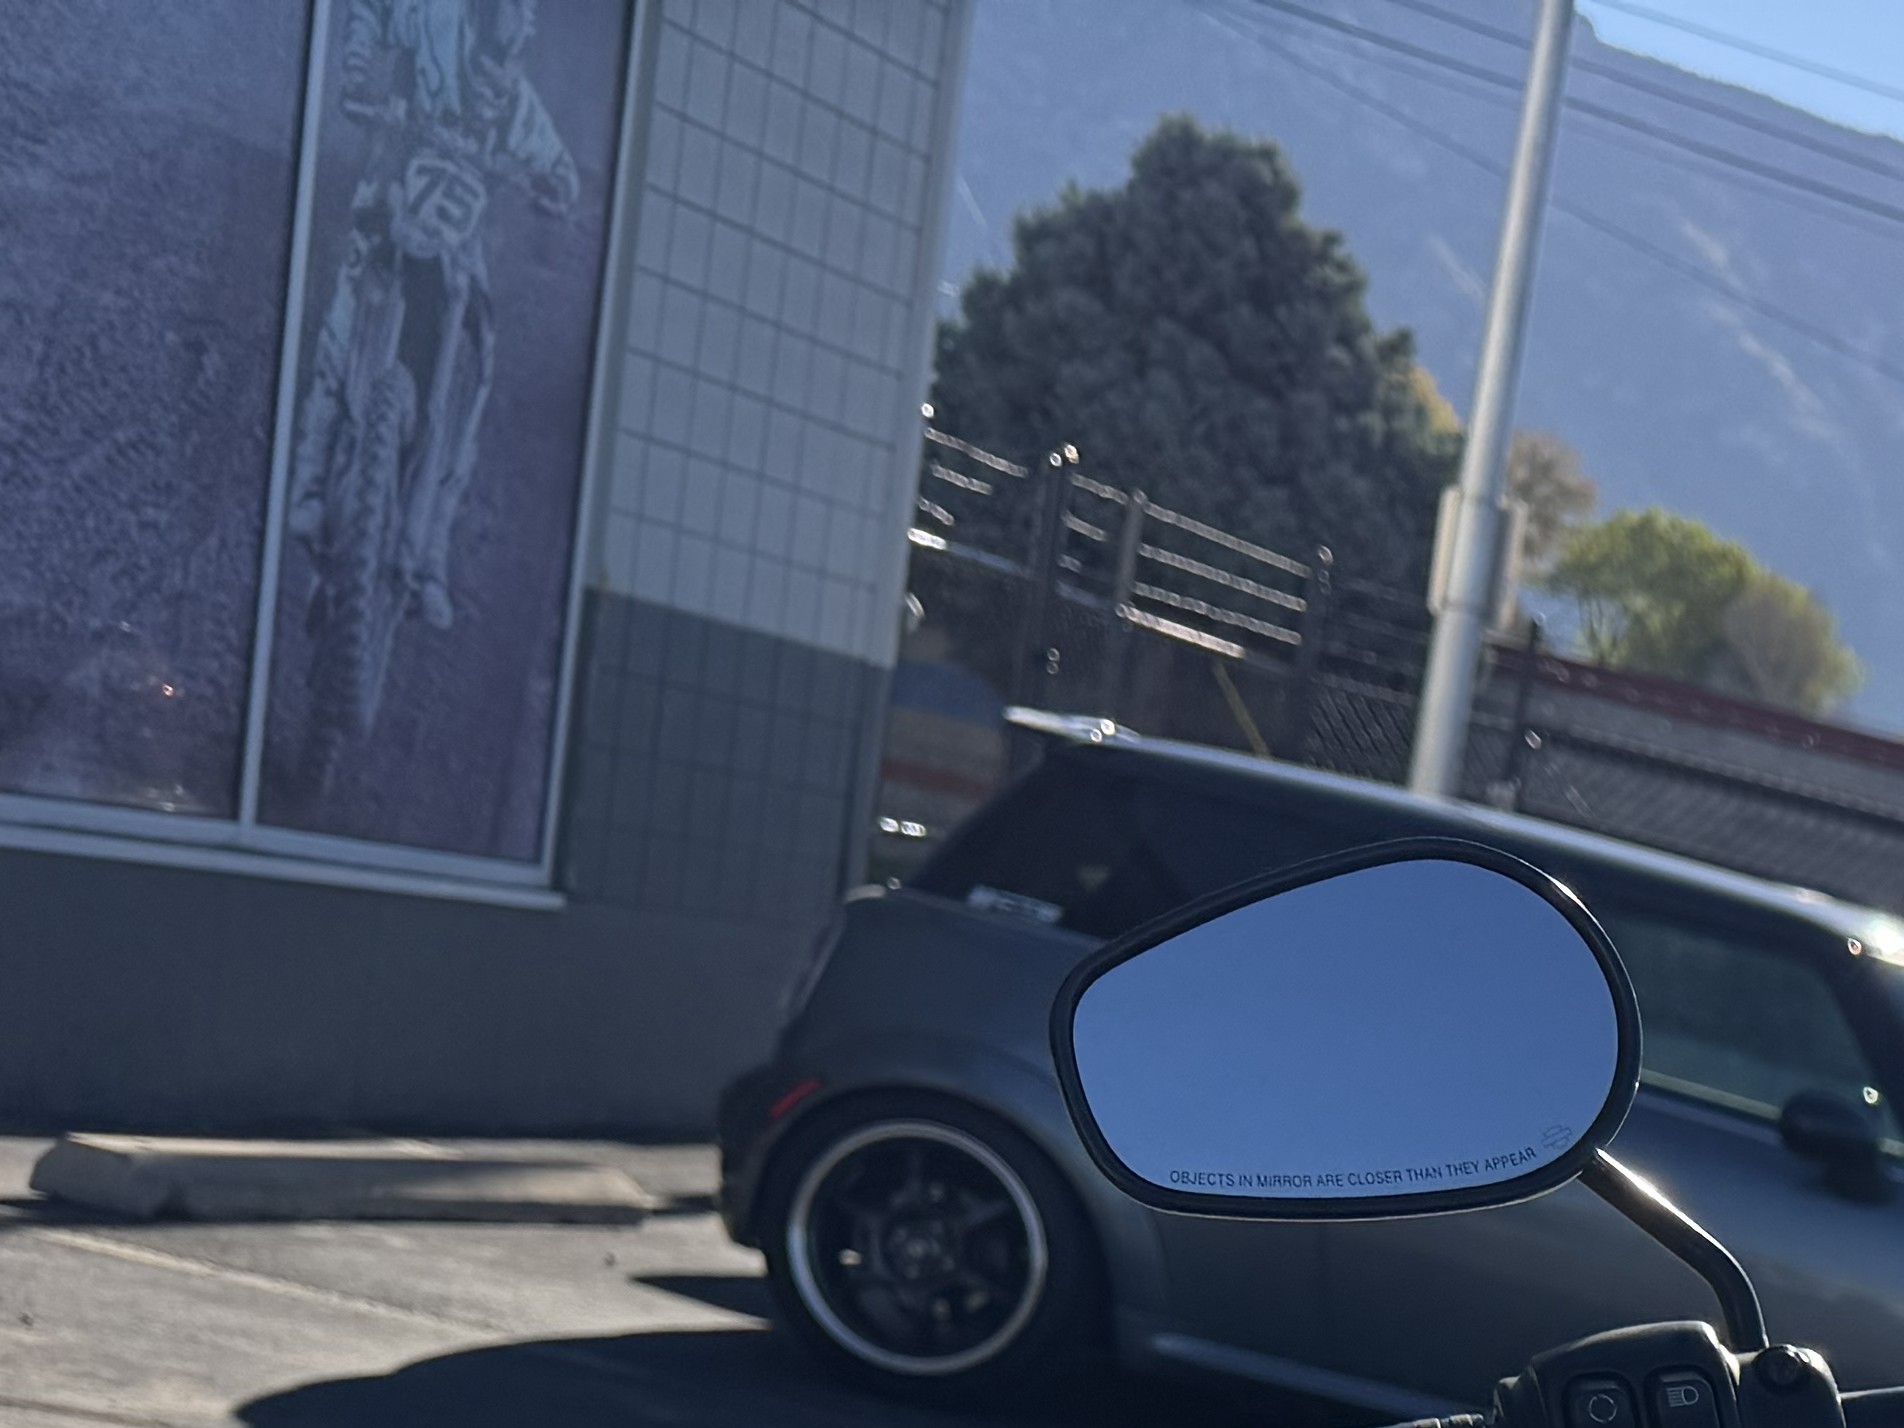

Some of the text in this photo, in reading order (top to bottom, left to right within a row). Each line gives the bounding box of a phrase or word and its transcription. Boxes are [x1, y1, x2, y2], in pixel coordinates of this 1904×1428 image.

[407, 164, 481, 234] 75
[1169, 1147, 1537, 1188] OBJECTS IN MIRROR ARE CLOSER THAN THEY APPEAR
